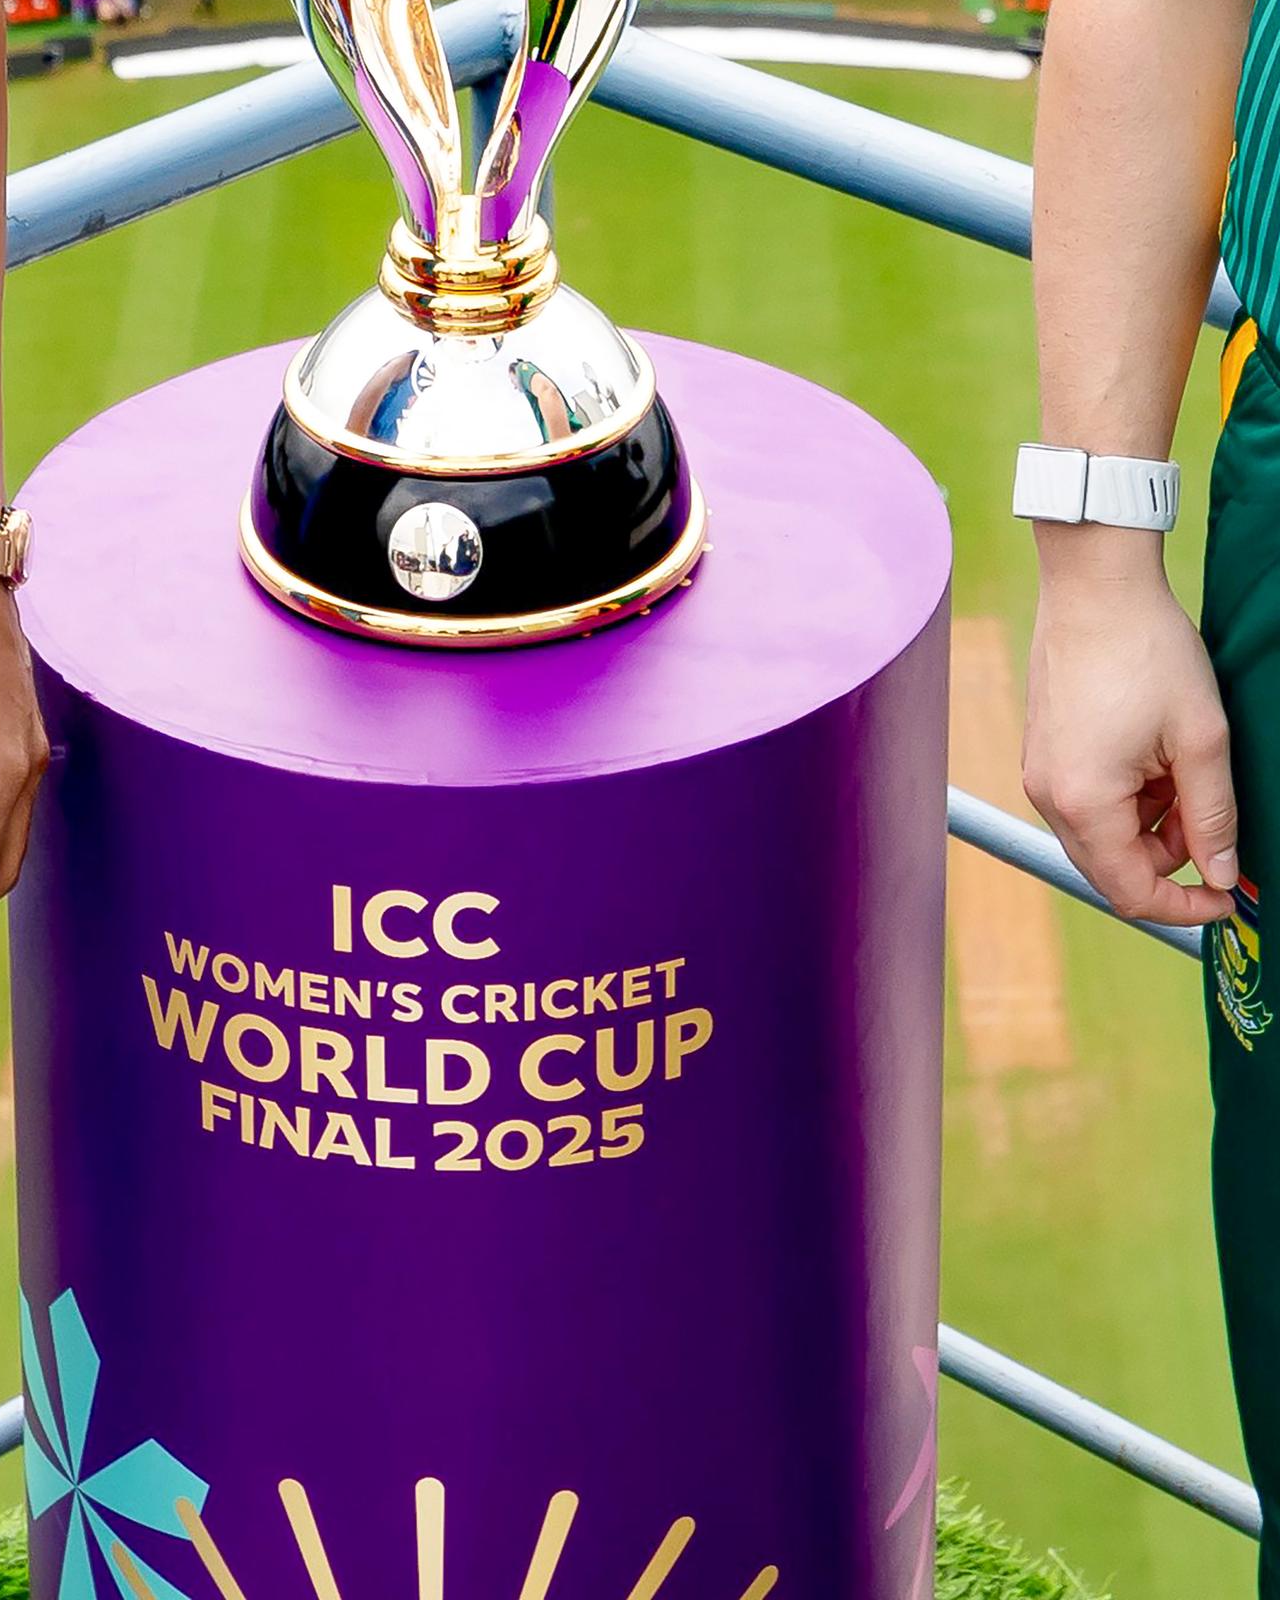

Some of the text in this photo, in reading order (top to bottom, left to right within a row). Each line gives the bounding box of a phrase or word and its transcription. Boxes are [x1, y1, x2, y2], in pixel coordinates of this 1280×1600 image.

[332, 884, 500, 960] ICC
[164, 930, 686, 1024] WOMEN'S CRICKET
[142, 974, 714, 1105] WORLD CUP
[200, 1079, 646, 1172] FINAL 2025
